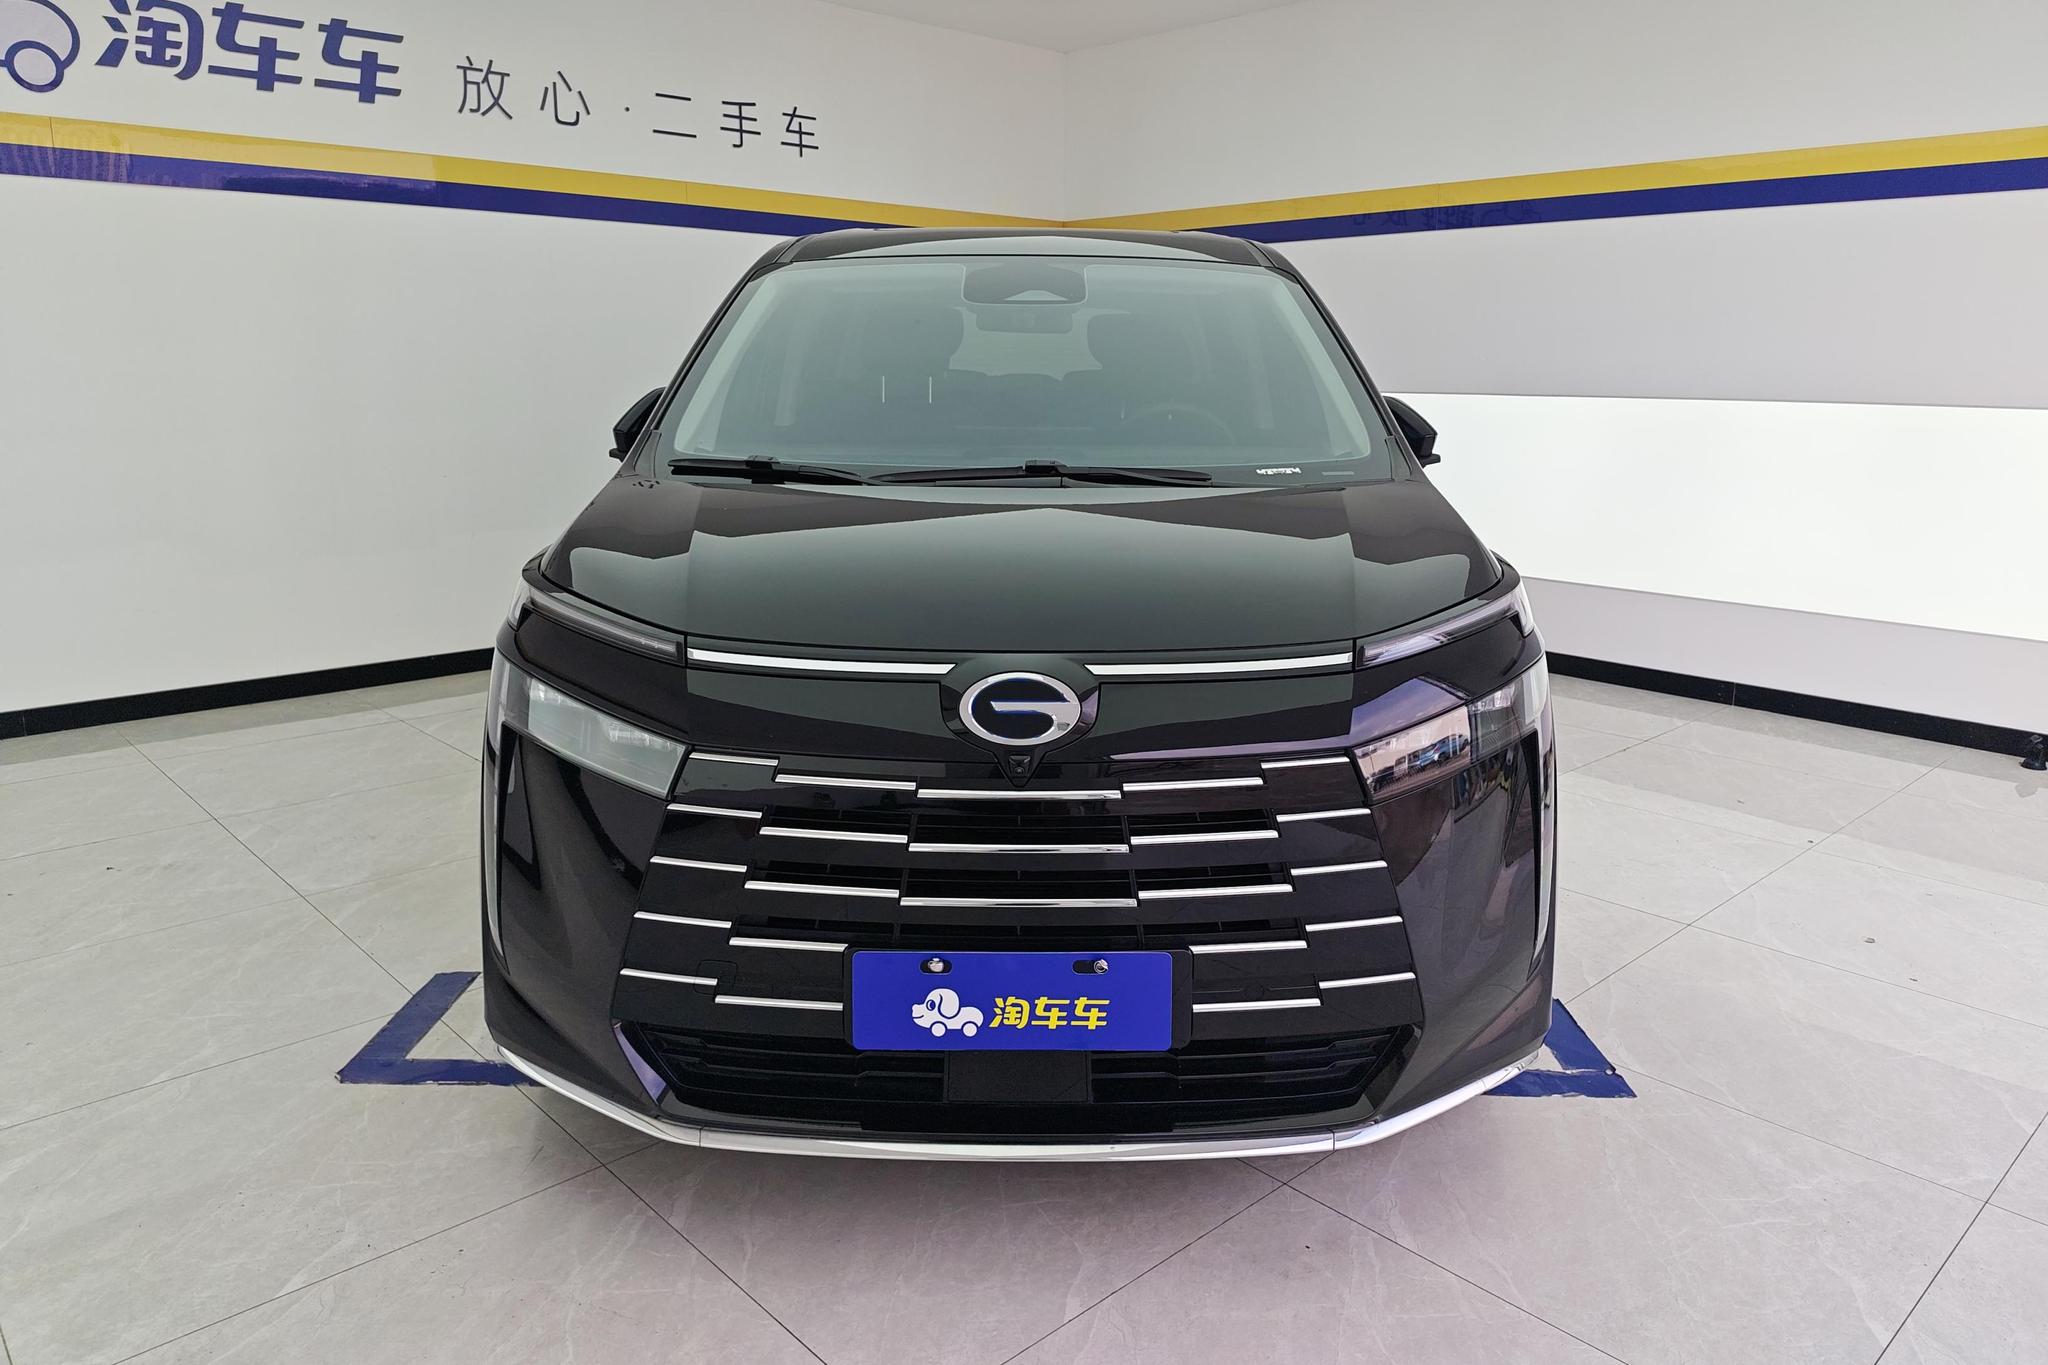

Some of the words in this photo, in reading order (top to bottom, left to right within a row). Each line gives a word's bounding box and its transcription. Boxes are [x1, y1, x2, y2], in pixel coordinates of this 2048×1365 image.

[94, 0, 404, 104] 淘车车
[989, 996, 1110, 1030] 淘车车
